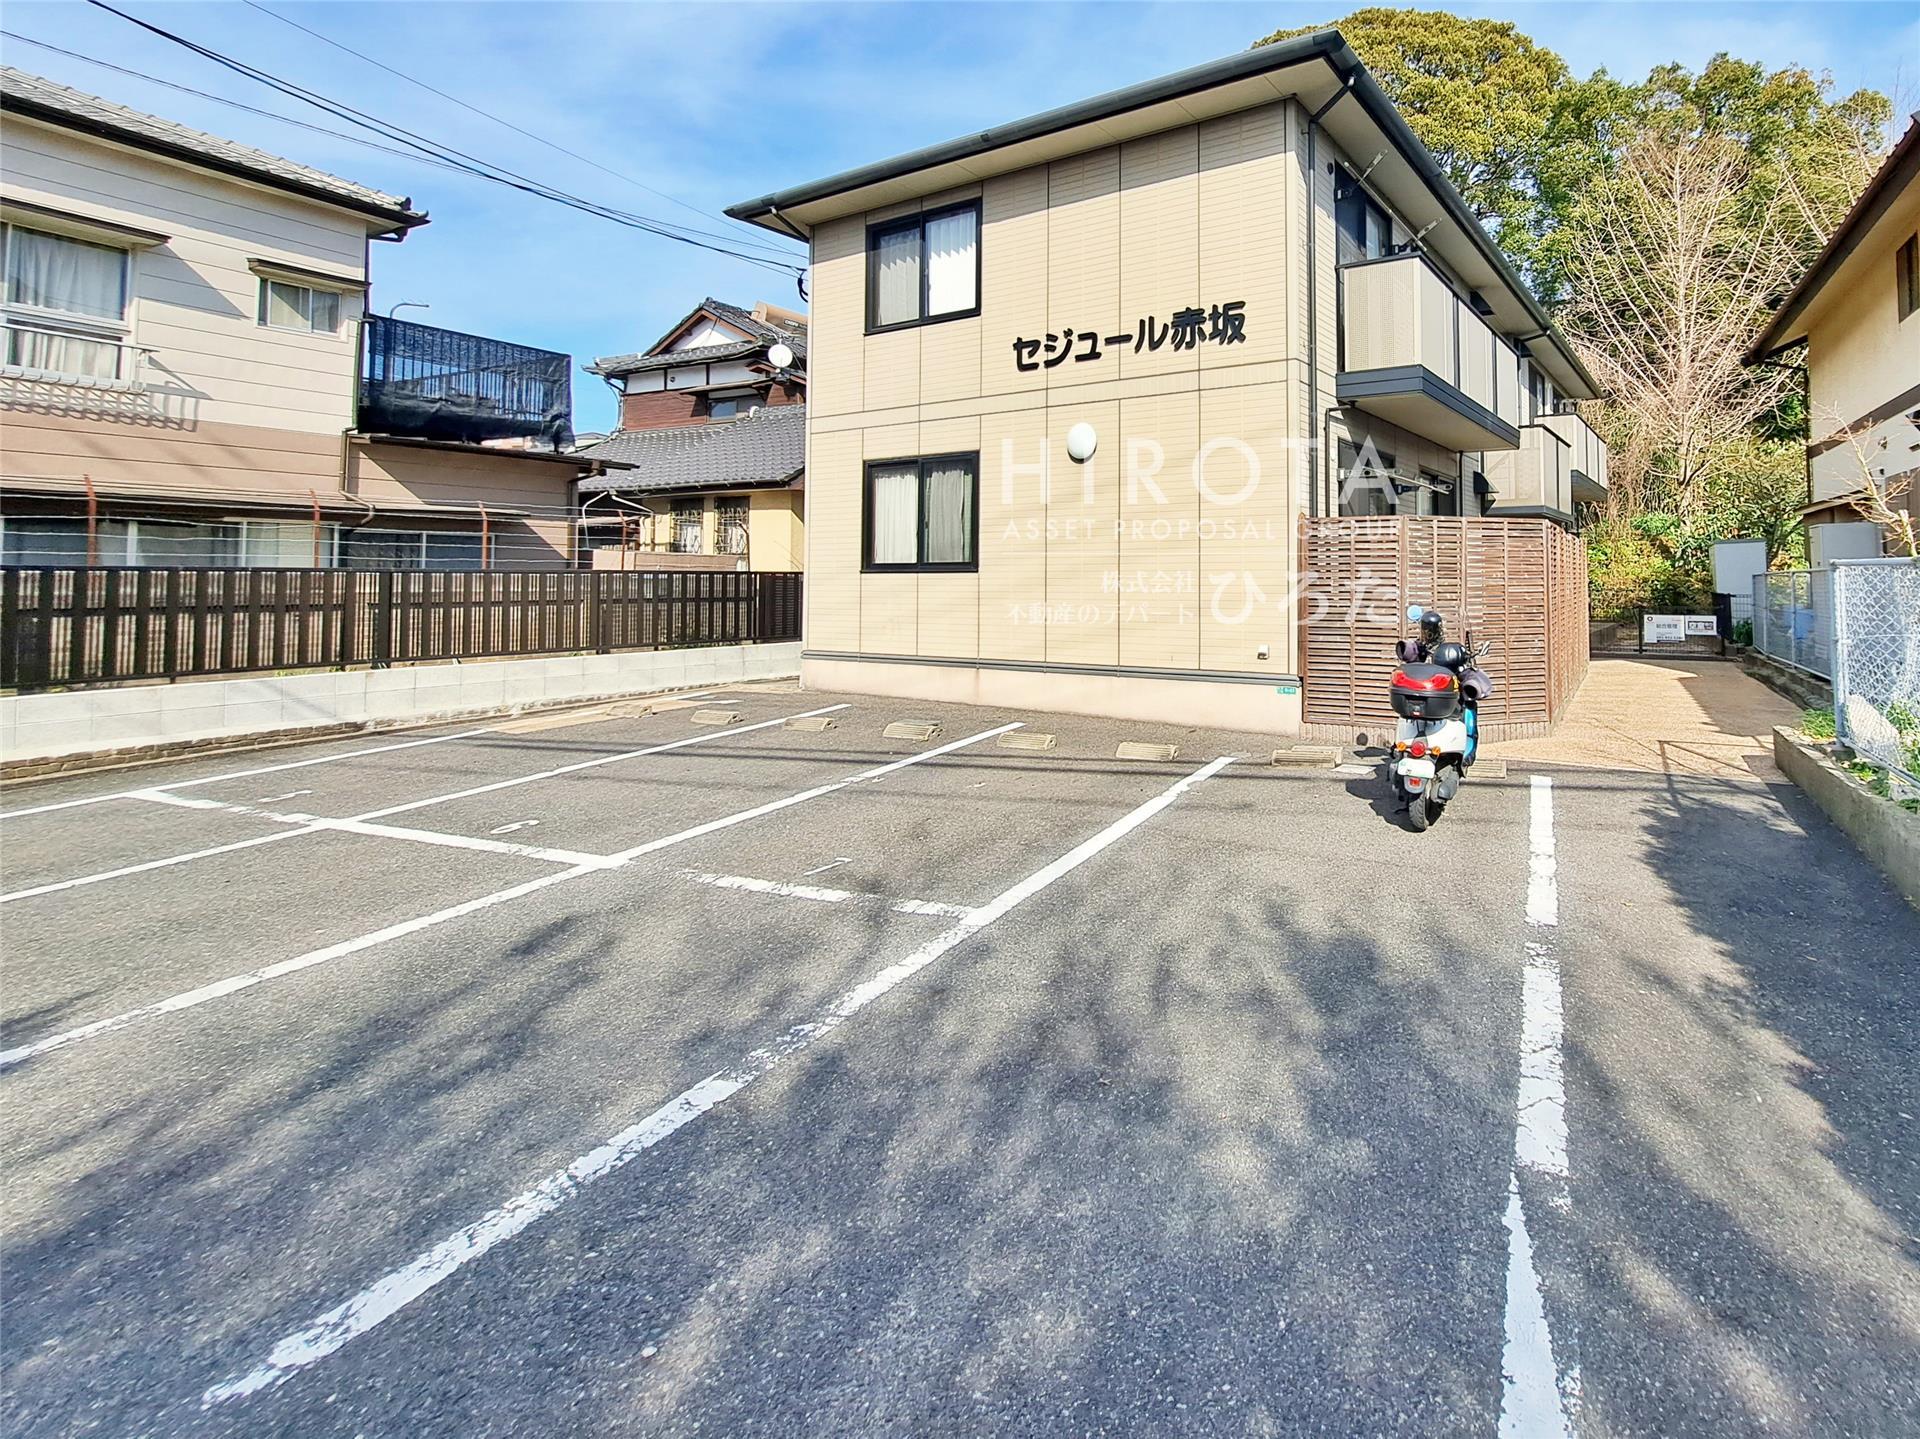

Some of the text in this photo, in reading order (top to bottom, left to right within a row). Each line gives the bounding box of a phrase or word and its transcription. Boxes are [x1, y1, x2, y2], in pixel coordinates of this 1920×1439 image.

[1012, 300, 1247, 373] セジュール赤坂
[489, 819, 540, 835] 6
